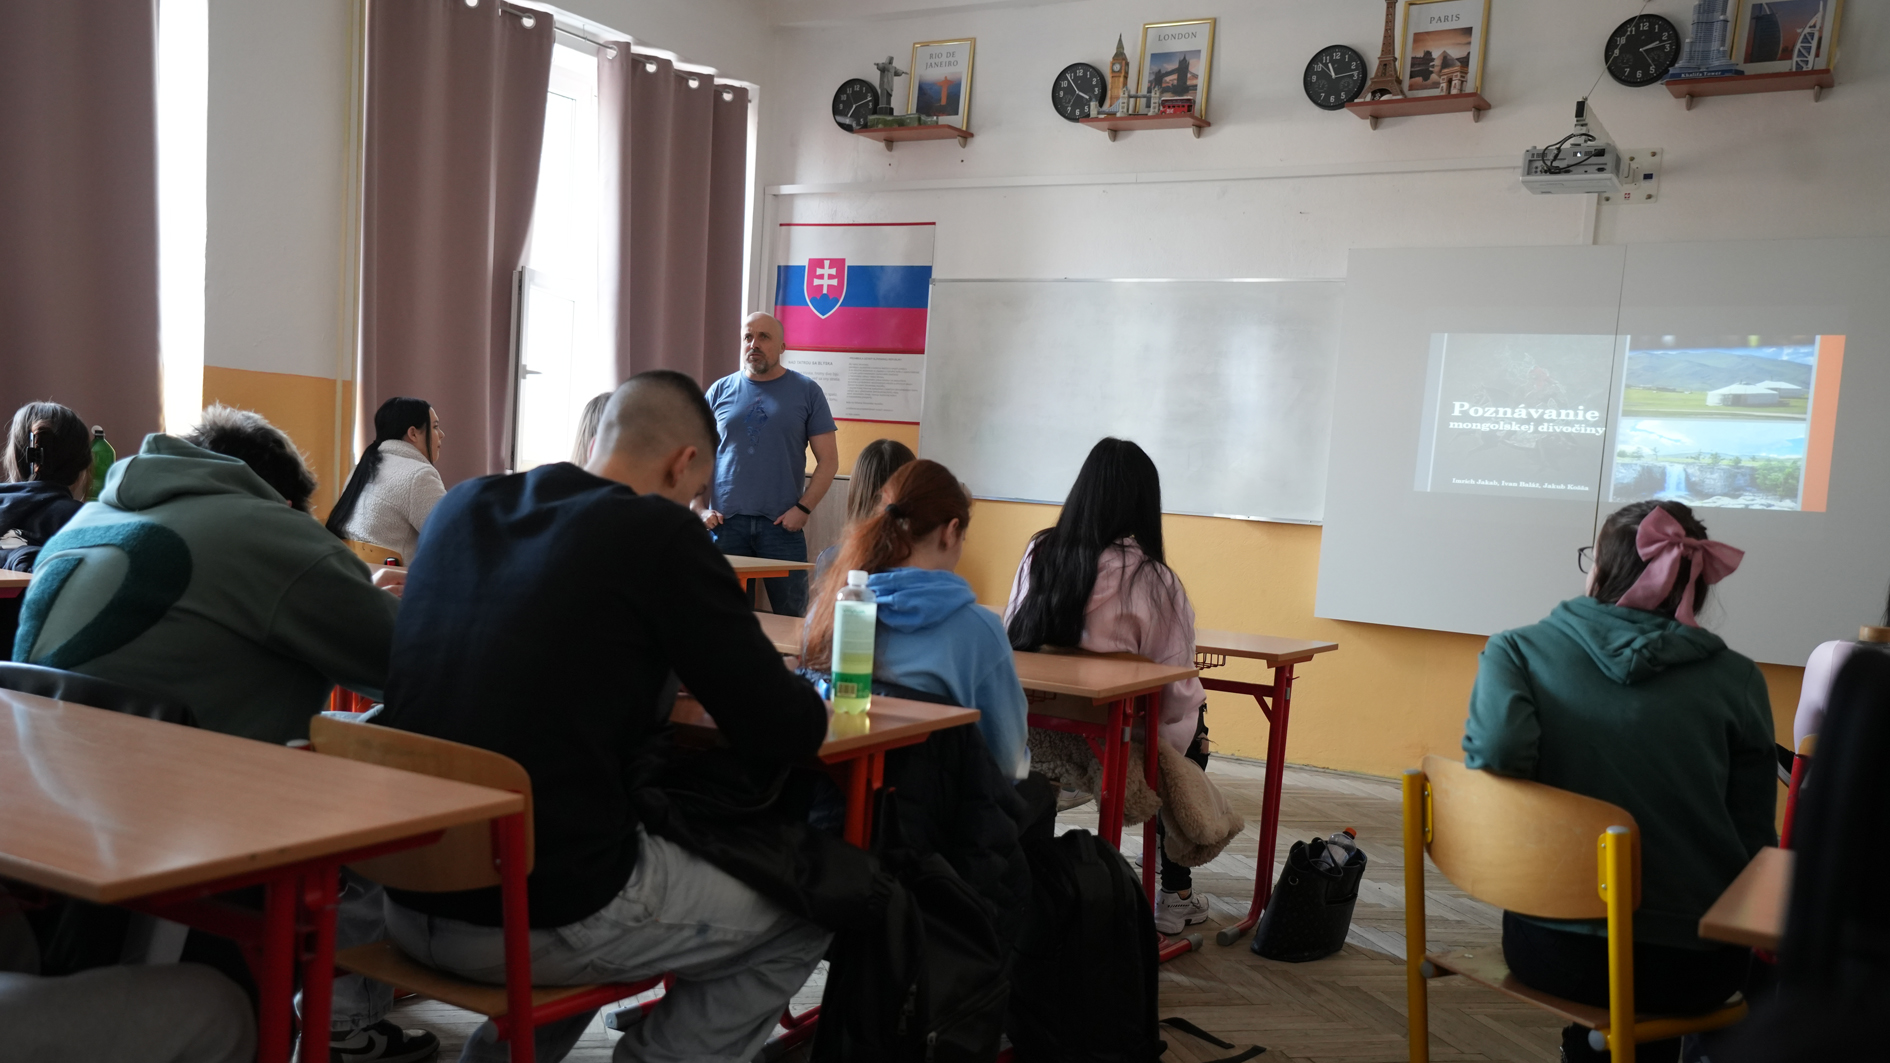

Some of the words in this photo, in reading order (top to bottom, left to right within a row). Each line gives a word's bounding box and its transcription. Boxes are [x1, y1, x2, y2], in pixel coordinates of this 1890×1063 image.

[1429, 13, 1461, 24] PARIS
[1640, 22, 1649, 30] 12
[1655, 24, 1658, 32] 1
[1628, 27, 1635, 35] 11
[1158, 31, 1197, 42] LONDON
[1662, 32, 1668, 40] 2
[1617, 36, 1626, 45] 10
[1664, 44, 1670, 52] 3
[929, 52, 943, 60] RIO
[945, 51, 956, 59] DE
[1323, 55, 1330, 63] 11
[1332, 52, 1341, 60] 12
[925, 60, 959, 70] JANEIRO
[1351, 61, 1356, 69] 2
[1624, 68, 1630, 76] 7
[1636, 70, 1642, 78] 6
[1649, 66, 1655, 74] 5
[1353, 72, 1358, 80] 3
[1451, 401, 1600, 421] Poznávanie
[1449, 421, 1534, 433] mongolskej
[1538, 423, 1606, 436] divočiny
[1452, 477, 1475, 485] Imrich
[1542, 482, 1566, 490] Jakub
